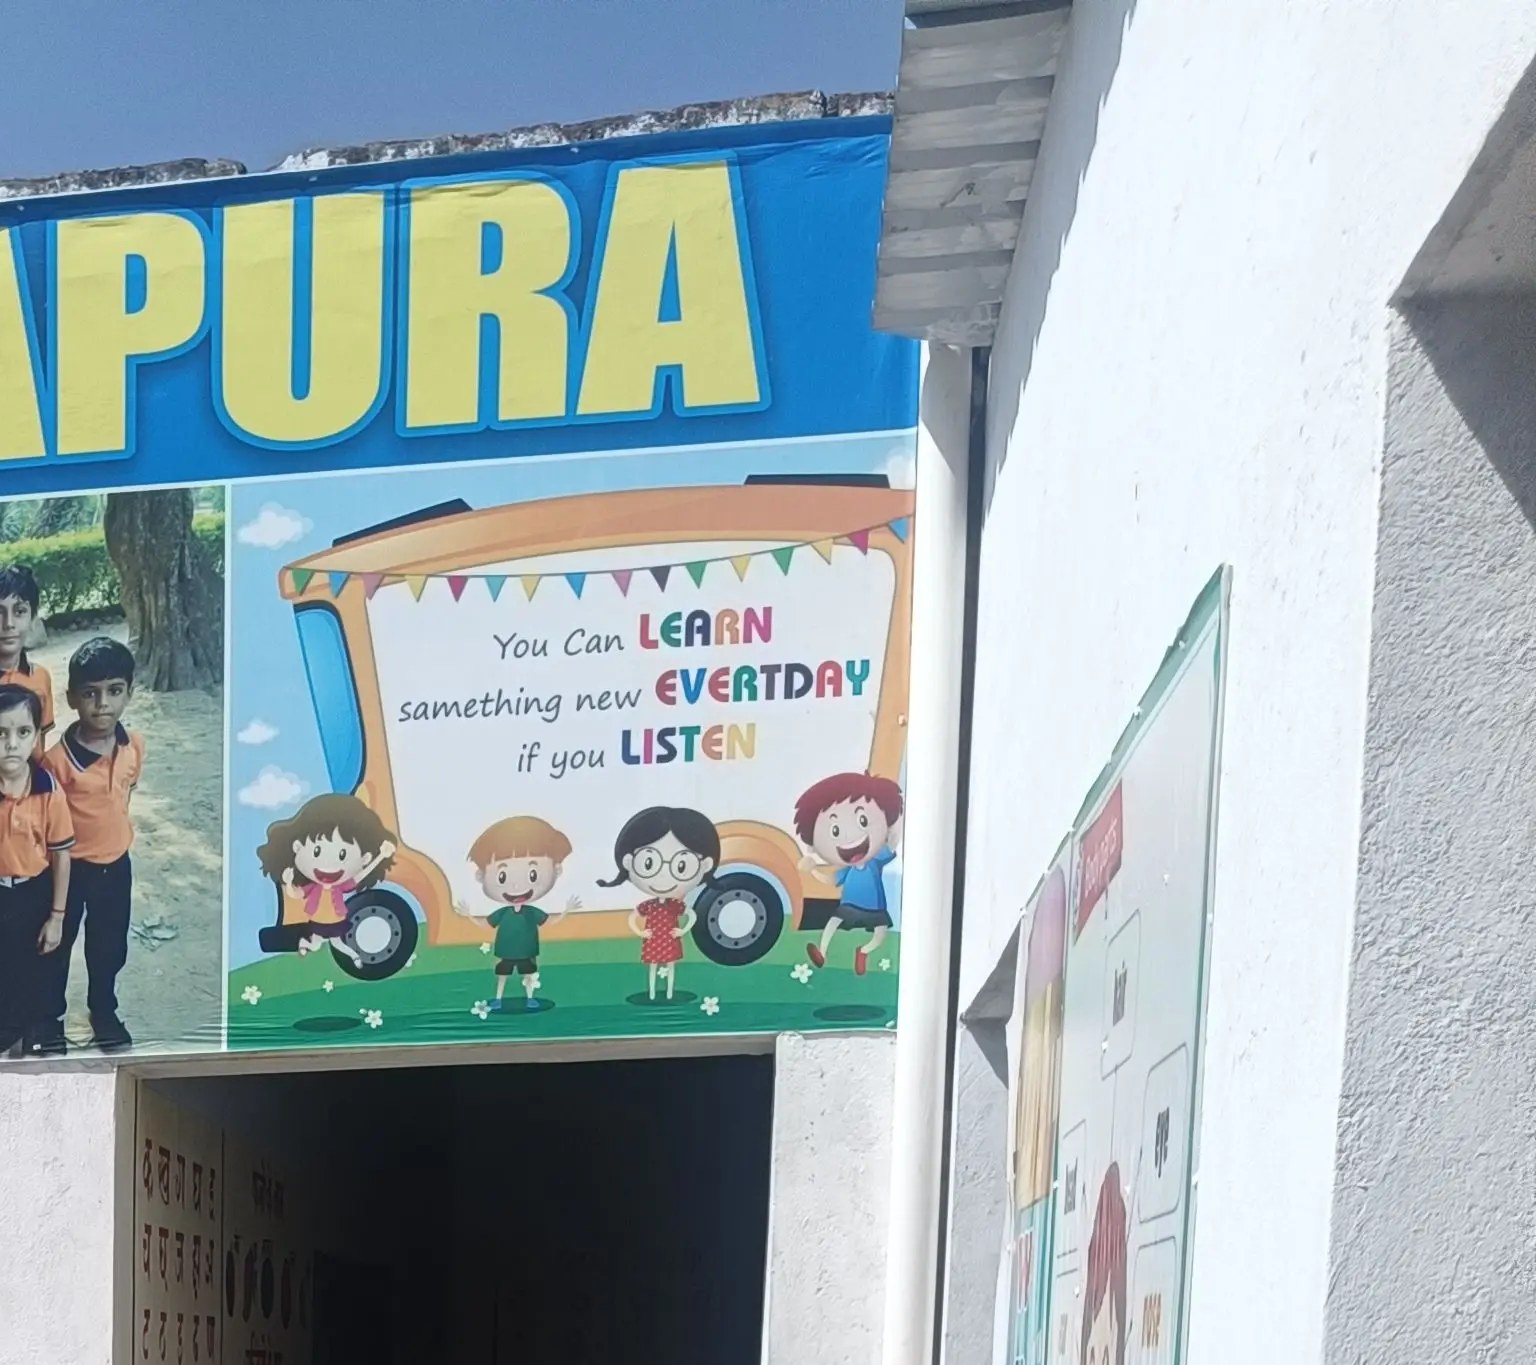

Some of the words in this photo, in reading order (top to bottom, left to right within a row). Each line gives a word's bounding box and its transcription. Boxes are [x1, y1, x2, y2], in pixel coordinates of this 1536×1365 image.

[492, 630, 549, 660] You
[563, 627, 626, 656] Can
[639, 605, 773, 651] LEARN
[575, 686, 642, 712] new
[655, 659, 871, 706] EVERTDAY
[516, 744, 542, 773] if
[549, 748, 606, 779] you
[621, 722, 756, 766] LISTEN
[1155, 1105, 1170, 1179] eye
